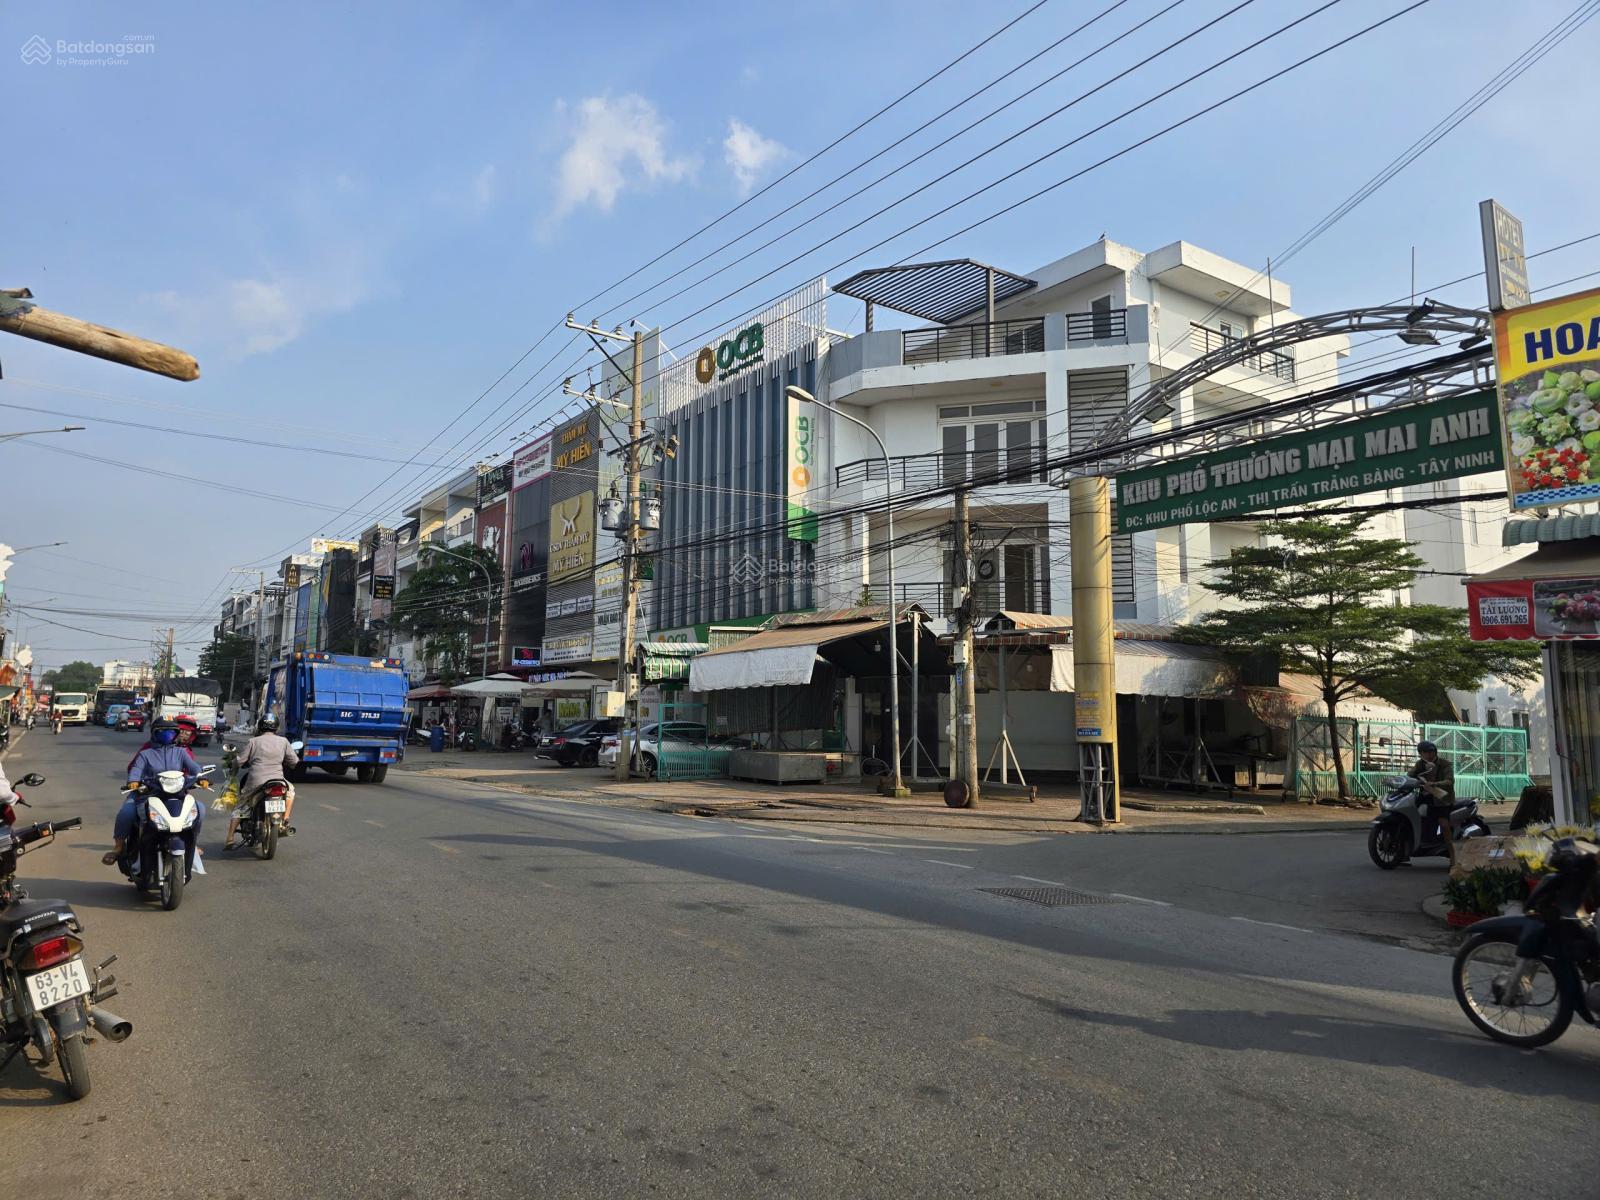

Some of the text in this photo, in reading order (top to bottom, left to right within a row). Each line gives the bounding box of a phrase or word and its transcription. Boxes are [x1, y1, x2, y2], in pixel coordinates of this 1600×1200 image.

[717, 322, 764, 370] OCB
[795, 416, 809, 464] OCB
[1123, 407, 1491, 506] KHU PHỐ THƯƠNG MẠI MAI ANH
[1126, 516, 1143, 528] ĐC:
[1146, 511, 1168, 524] KHU
[1171, 500, 1193, 520] PHỐ
[1196, 499, 1219, 517] LỘC
[1221, 498, 1237, 511] AN
[1249, 493, 1269, 506] THỊ
[1272, 481, 1308, 501] TRẤN
[1363, 465, 1405, 486] BÀNG
[1418, 457, 1451, 476] TÂY
[1454, 450, 1496, 470] NINH
[1481, 614, 1528, 625] 0906.691.265
[1482, 604, 1528, 615] TÀI LƯƠNG
[35, 963, 79, 990] 63-V4
[39, 979, 83, 1006] 8220
